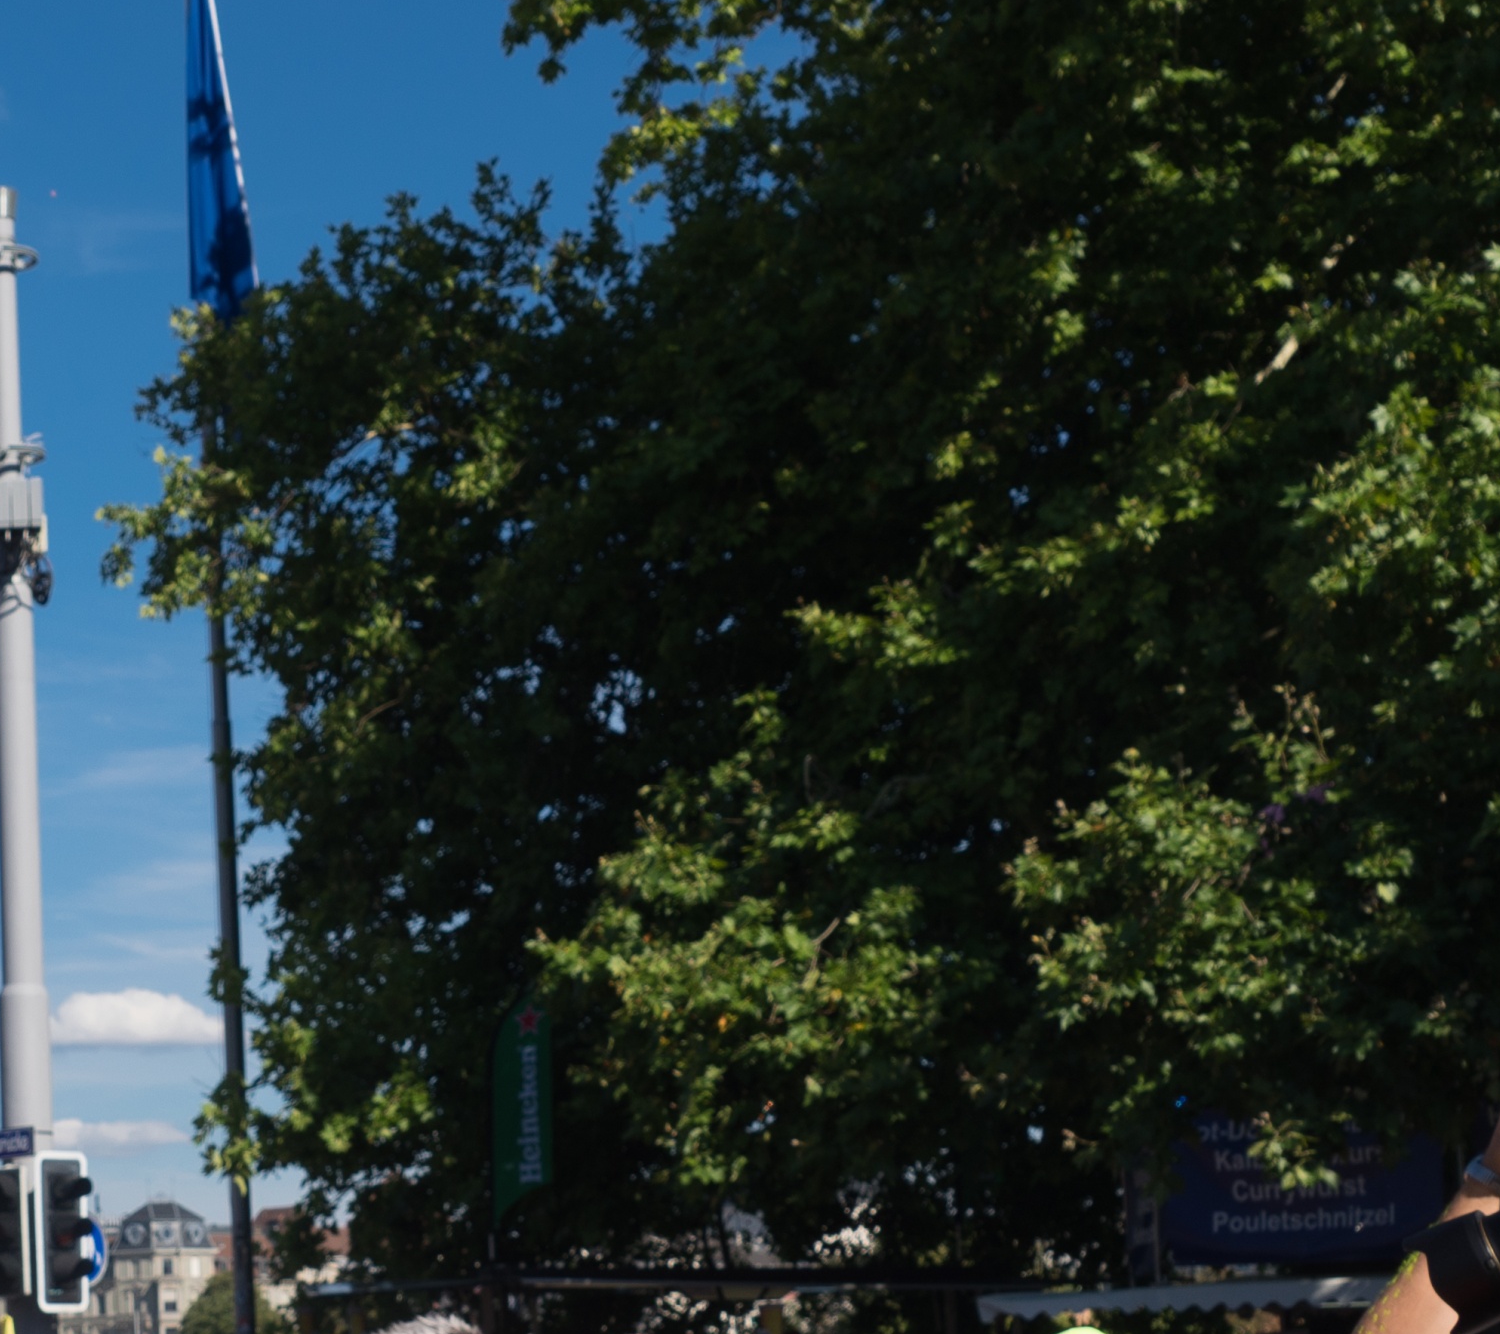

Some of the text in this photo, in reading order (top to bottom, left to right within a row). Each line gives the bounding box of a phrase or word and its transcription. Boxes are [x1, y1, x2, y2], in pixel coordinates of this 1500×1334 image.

[517, 1044, 543, 1183] Heineken
[1231, 1174, 1366, 1206] Currywurst
[1211, 1203, 1396, 1234] Pouletschnitzel
